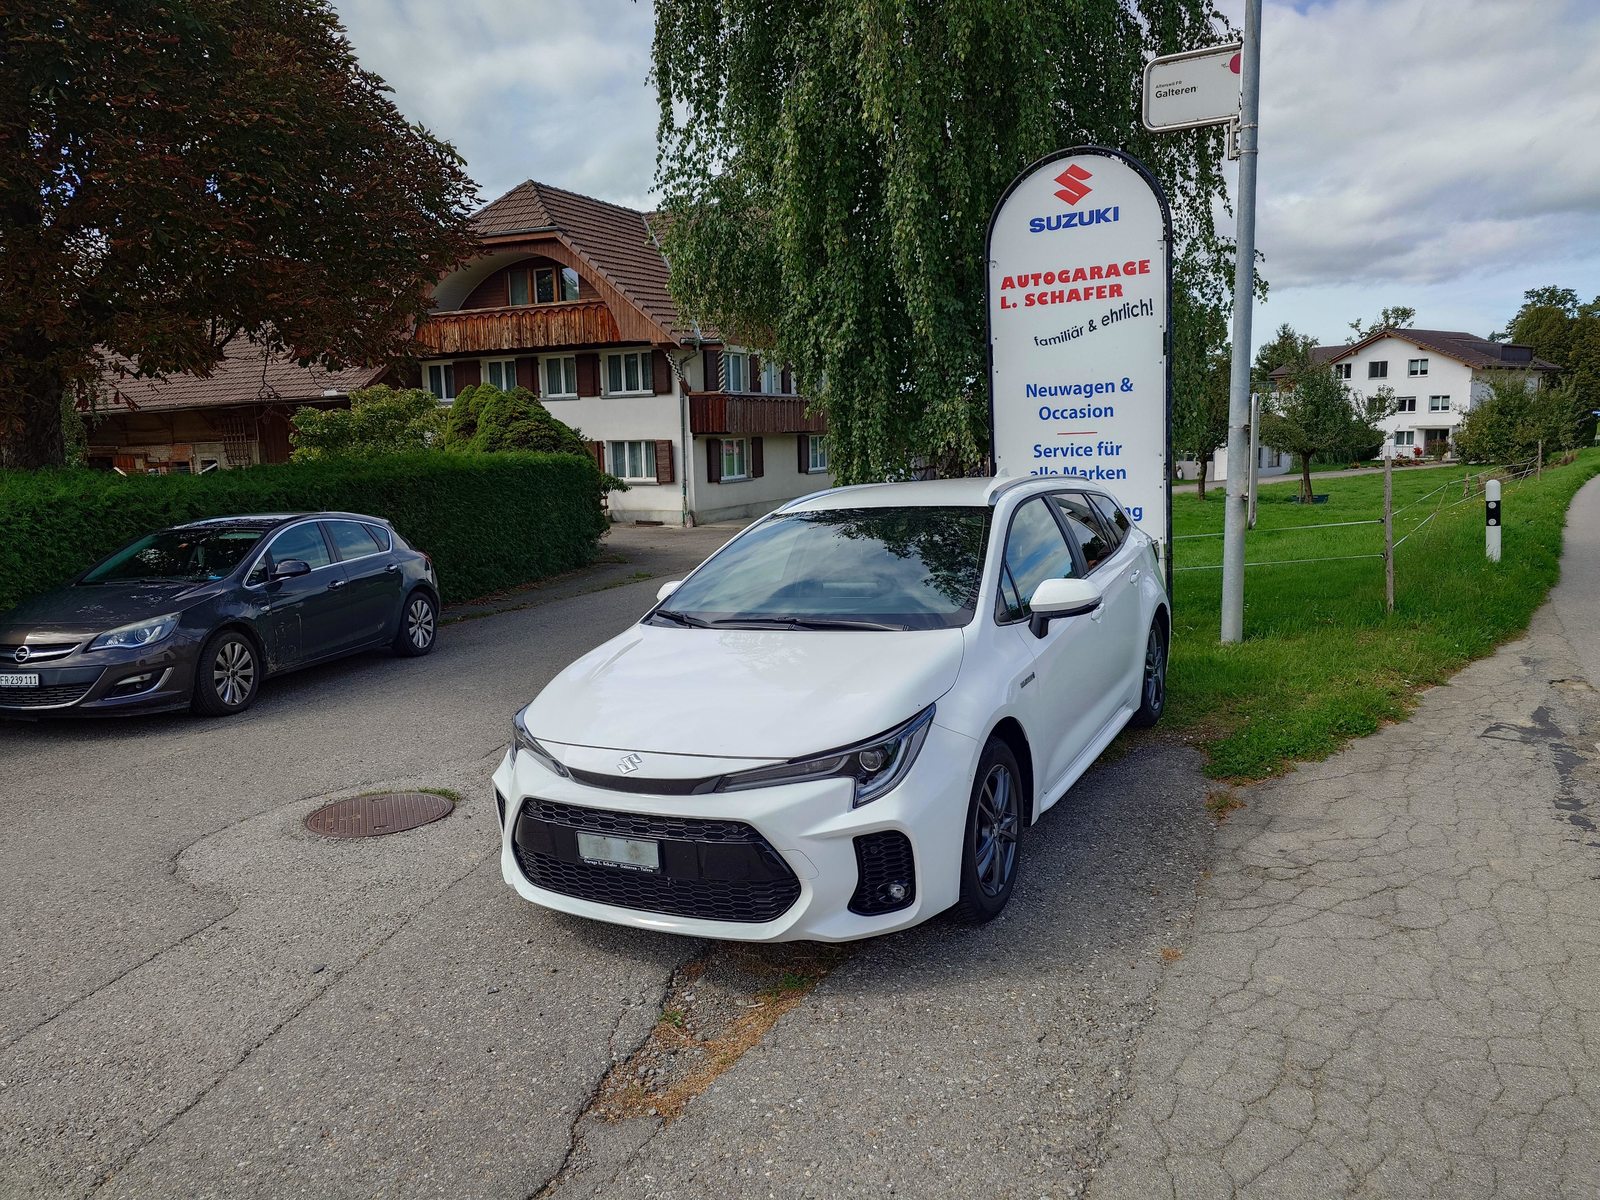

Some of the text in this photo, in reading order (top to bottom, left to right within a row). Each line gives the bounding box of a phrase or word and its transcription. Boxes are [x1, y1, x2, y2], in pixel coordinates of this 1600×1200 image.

[1155, 86, 1196, 99] Galteren
[1029, 206, 1120, 233] SUZUKI
[1001, 259, 1151, 290] AUTOGARAGE
[1000, 283, 1123, 309] L. SCHAFER
[1034, 298, 1154, 347] familiär & ehrlich!
[1026, 377, 1134, 398] Neuwagen &
[1038, 404, 1114, 420] Occasion
[1033, 441, 1123, 458] Service für
[1063, 465, 1127, 480] Marken
[10, 675, 23, 685] 239
[24, 675, 37, 685] 111
